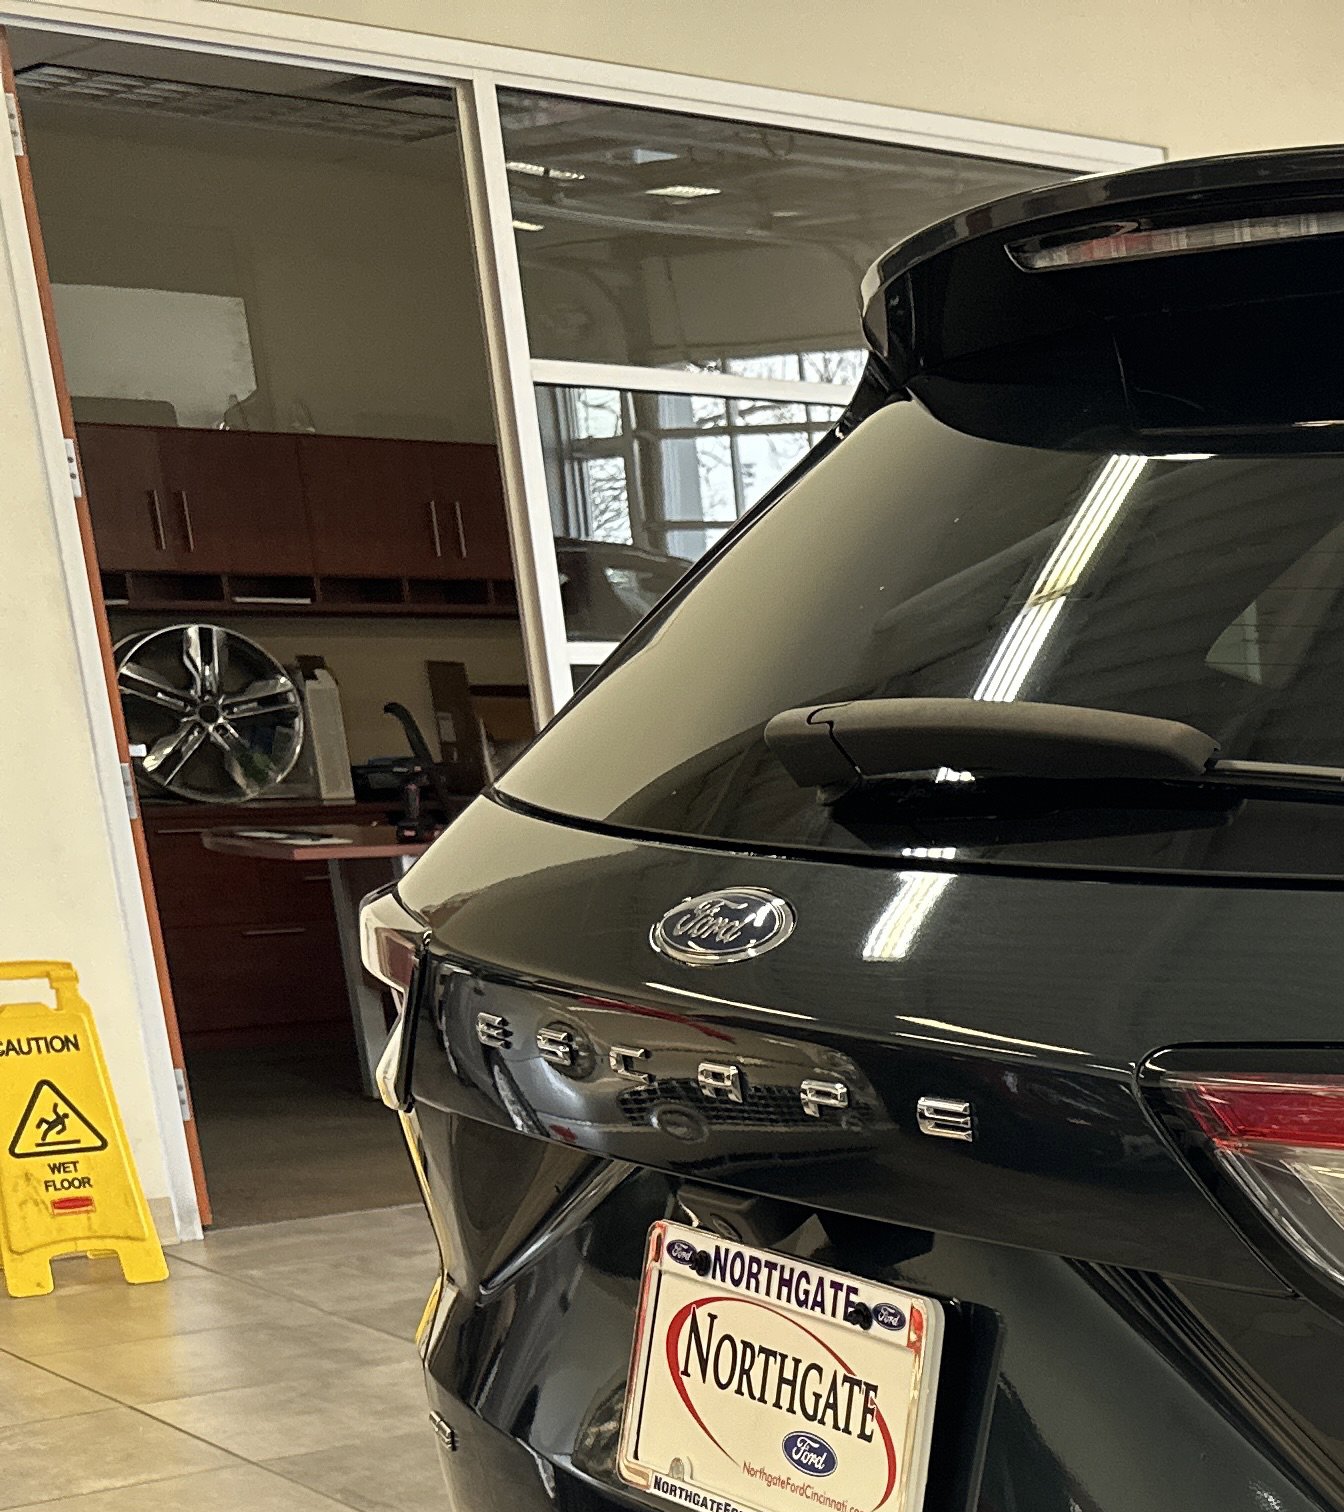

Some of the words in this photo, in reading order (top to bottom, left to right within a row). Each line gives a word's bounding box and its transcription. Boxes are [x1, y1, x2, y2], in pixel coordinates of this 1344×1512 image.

[475, 1011, 974, 1142] ESCAPE
[44, 1177, 93, 1192] FLOOR
[47, 1160, 79, 1175] WET
[711, 1245, 860, 1323] NORTHGATE
[681, 1304, 879, 1443] NORTHGATE
